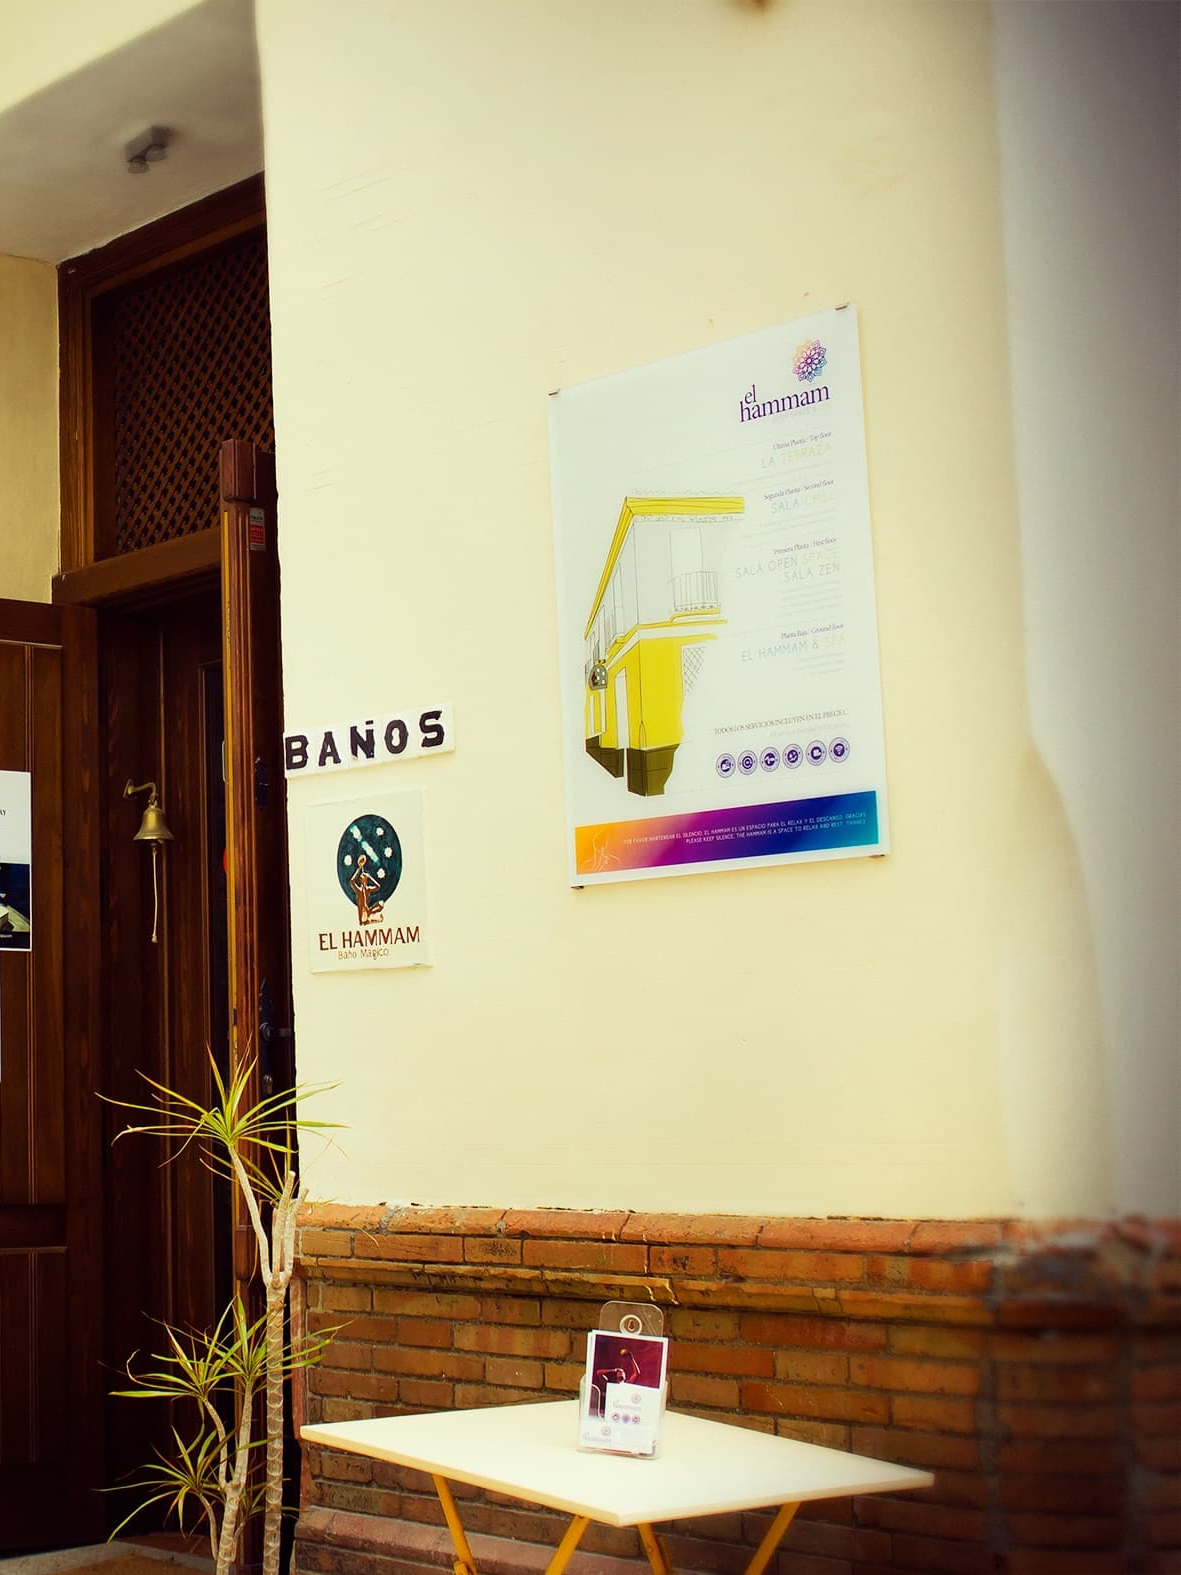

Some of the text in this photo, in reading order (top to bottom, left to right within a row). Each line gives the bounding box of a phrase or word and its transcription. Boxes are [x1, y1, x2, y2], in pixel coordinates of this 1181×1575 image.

[739, 385, 831, 423] hammam
[744, 384, 756, 405] el
[761, 442, 832, 469] LA TERRAZA
[771, 498, 799, 514] SALA
[735, 563, 764, 579] SALA
[768, 556, 797, 571] OPEN
[784, 561, 840, 583] SALA ZEN
[740, 649, 755, 662] EL
[758, 640, 806, 657] HAMMAM
[285, 710, 445, 770] BAÑOS
[318, 926, 421, 951] EL HAMMAM
